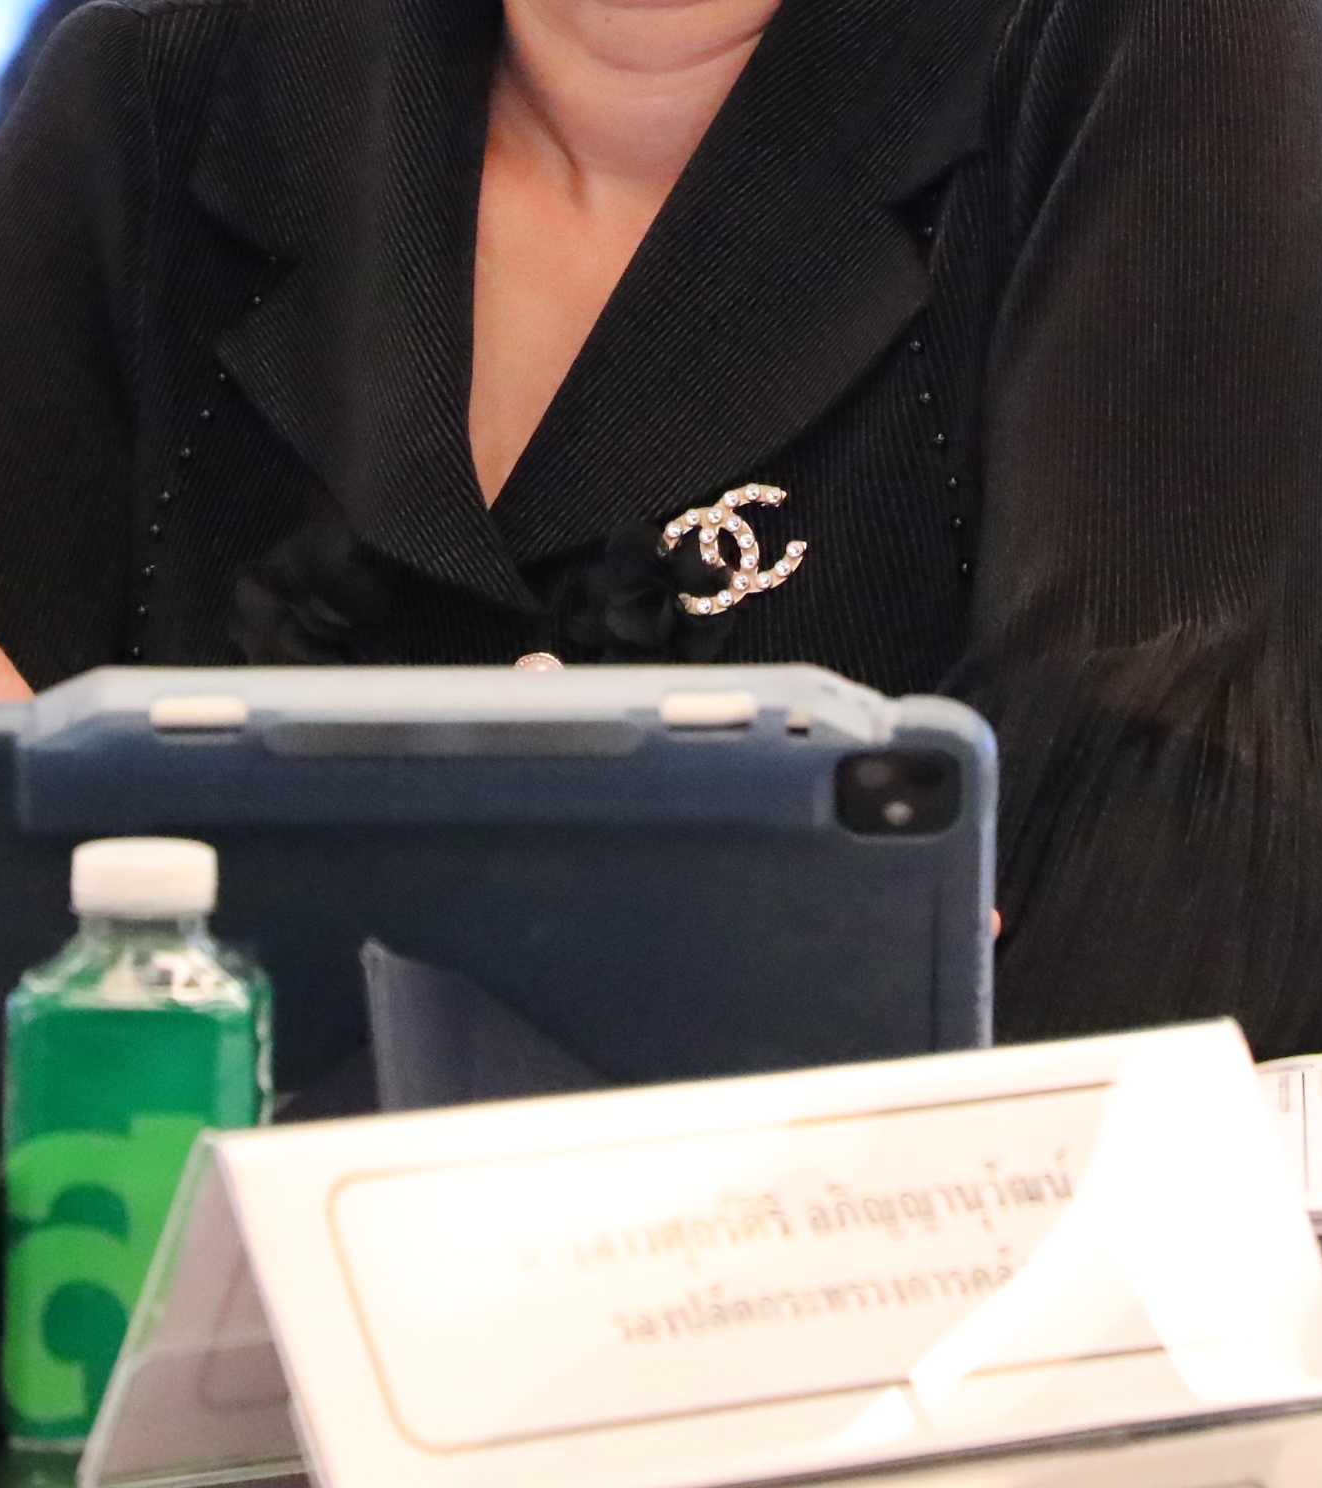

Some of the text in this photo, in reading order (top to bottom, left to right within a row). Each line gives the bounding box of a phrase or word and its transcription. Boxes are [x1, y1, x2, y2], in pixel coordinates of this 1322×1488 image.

[807, 1147, 1075, 1240] อภิญญานุวัฒน์
[611, 1245, 1029, 1343] รองปลัดกระทรวงการคลั
